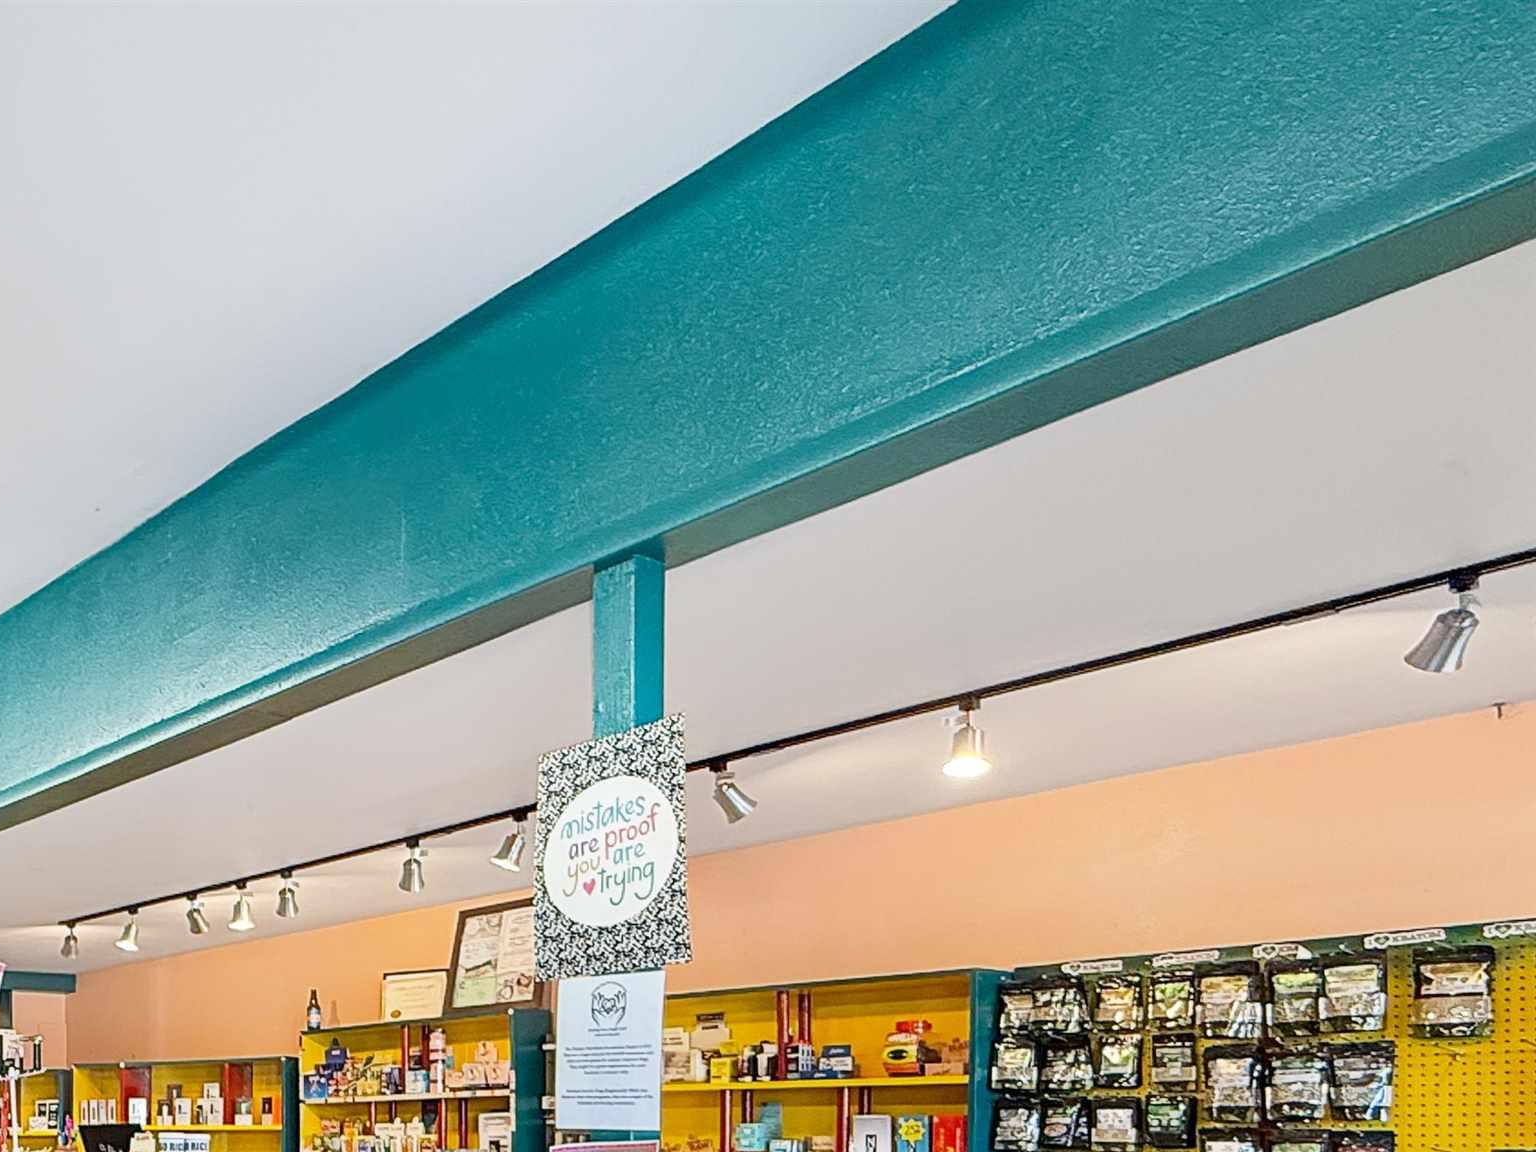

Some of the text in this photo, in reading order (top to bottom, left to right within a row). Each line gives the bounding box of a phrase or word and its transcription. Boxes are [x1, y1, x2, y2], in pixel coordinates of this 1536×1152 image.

[560, 796, 646, 839] mistakes
[569, 802, 661, 860] are proof
[562, 842, 646, 897] you are
[597, 861, 655, 906] trying
